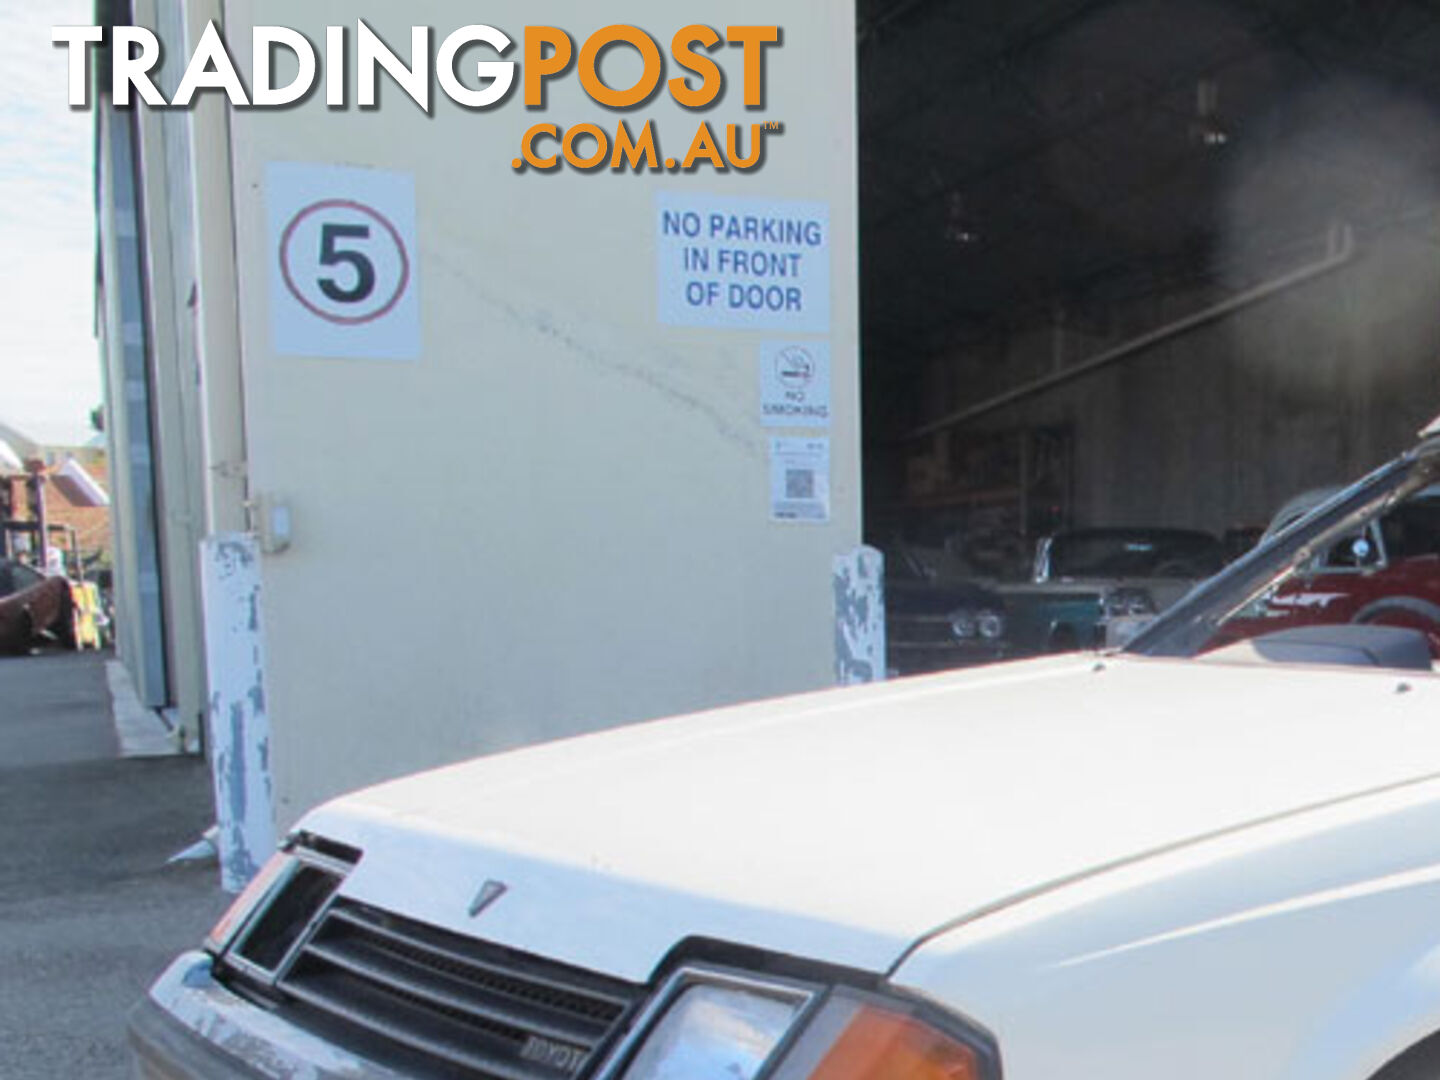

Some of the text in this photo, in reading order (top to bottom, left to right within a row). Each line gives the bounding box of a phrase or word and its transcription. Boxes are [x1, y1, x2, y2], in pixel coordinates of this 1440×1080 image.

[663, 210, 822, 247] NO PARKING
[317, 222, 375, 304] 5
[684, 246, 802, 277] IN FRONT
[686, 281, 803, 312] OF DOOR
[762, 404, 829, 418] SMOKING
[784, 390, 806, 403] NO
